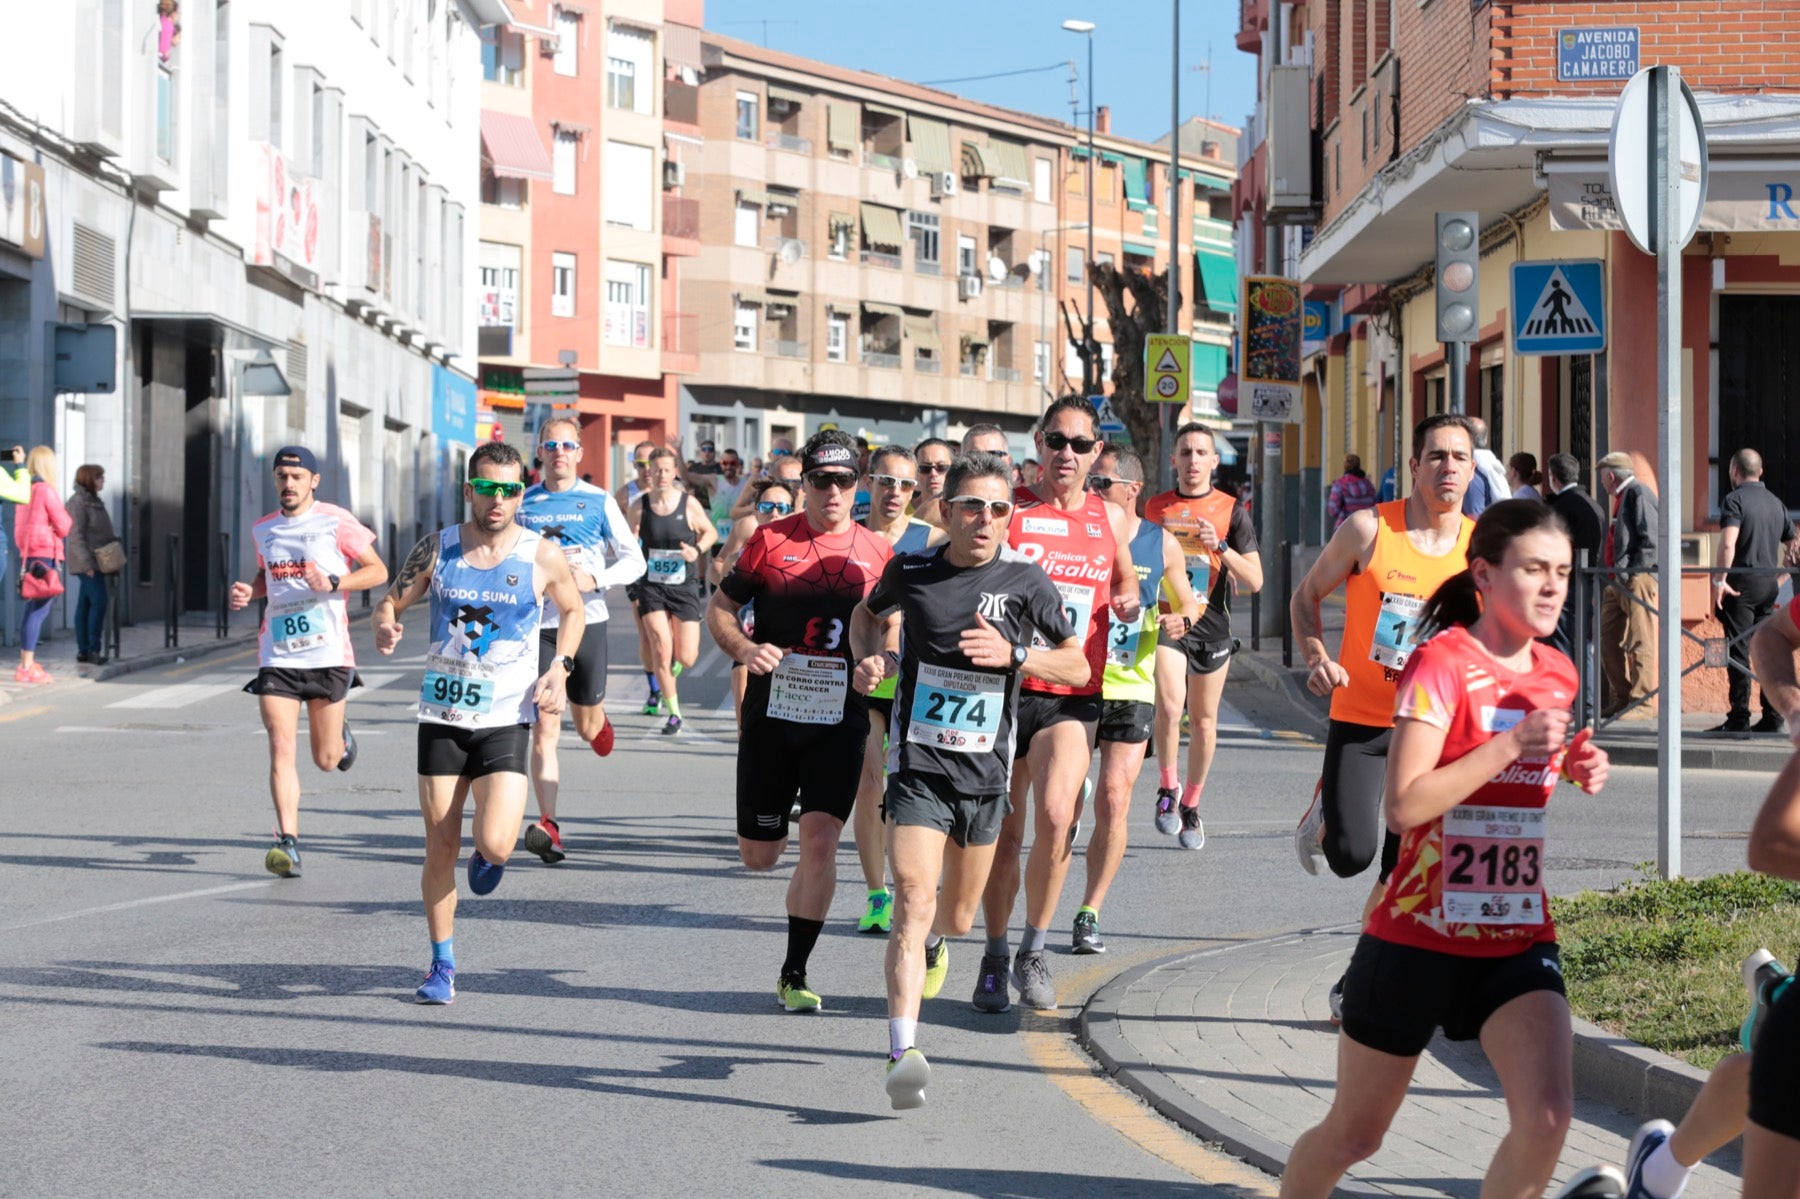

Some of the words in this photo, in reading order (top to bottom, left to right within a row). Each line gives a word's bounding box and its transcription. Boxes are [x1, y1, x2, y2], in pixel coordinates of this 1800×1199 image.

[1577, 31, 1635, 43] AVENIDA
[1581, 44, 1630, 60] JACOBO
[1563, 61, 1635, 77] CAMARERO
[1583, 183, 1612, 194] TOL
[1161, 381, 1174, 390] 20
[556, 513, 583, 522] SUMA
[654, 561, 679, 573] 852
[1016, 543, 1111, 582] Plisalud
[442, 588, 479, 600] TODO
[482, 591, 518, 604] SUMA
[284, 616, 310, 635] 86
[786, 674, 812, 684] CORRO
[937, 669, 952, 678] GRAN
[953, 672, 974, 682] PREMIO
[982, 676, 1000, 685] FONDO
[434, 677, 482, 706] 995
[785, 692, 812, 702] aecc
[925, 692, 986, 727] 274
[1448, 844, 1539, 886] 2183
